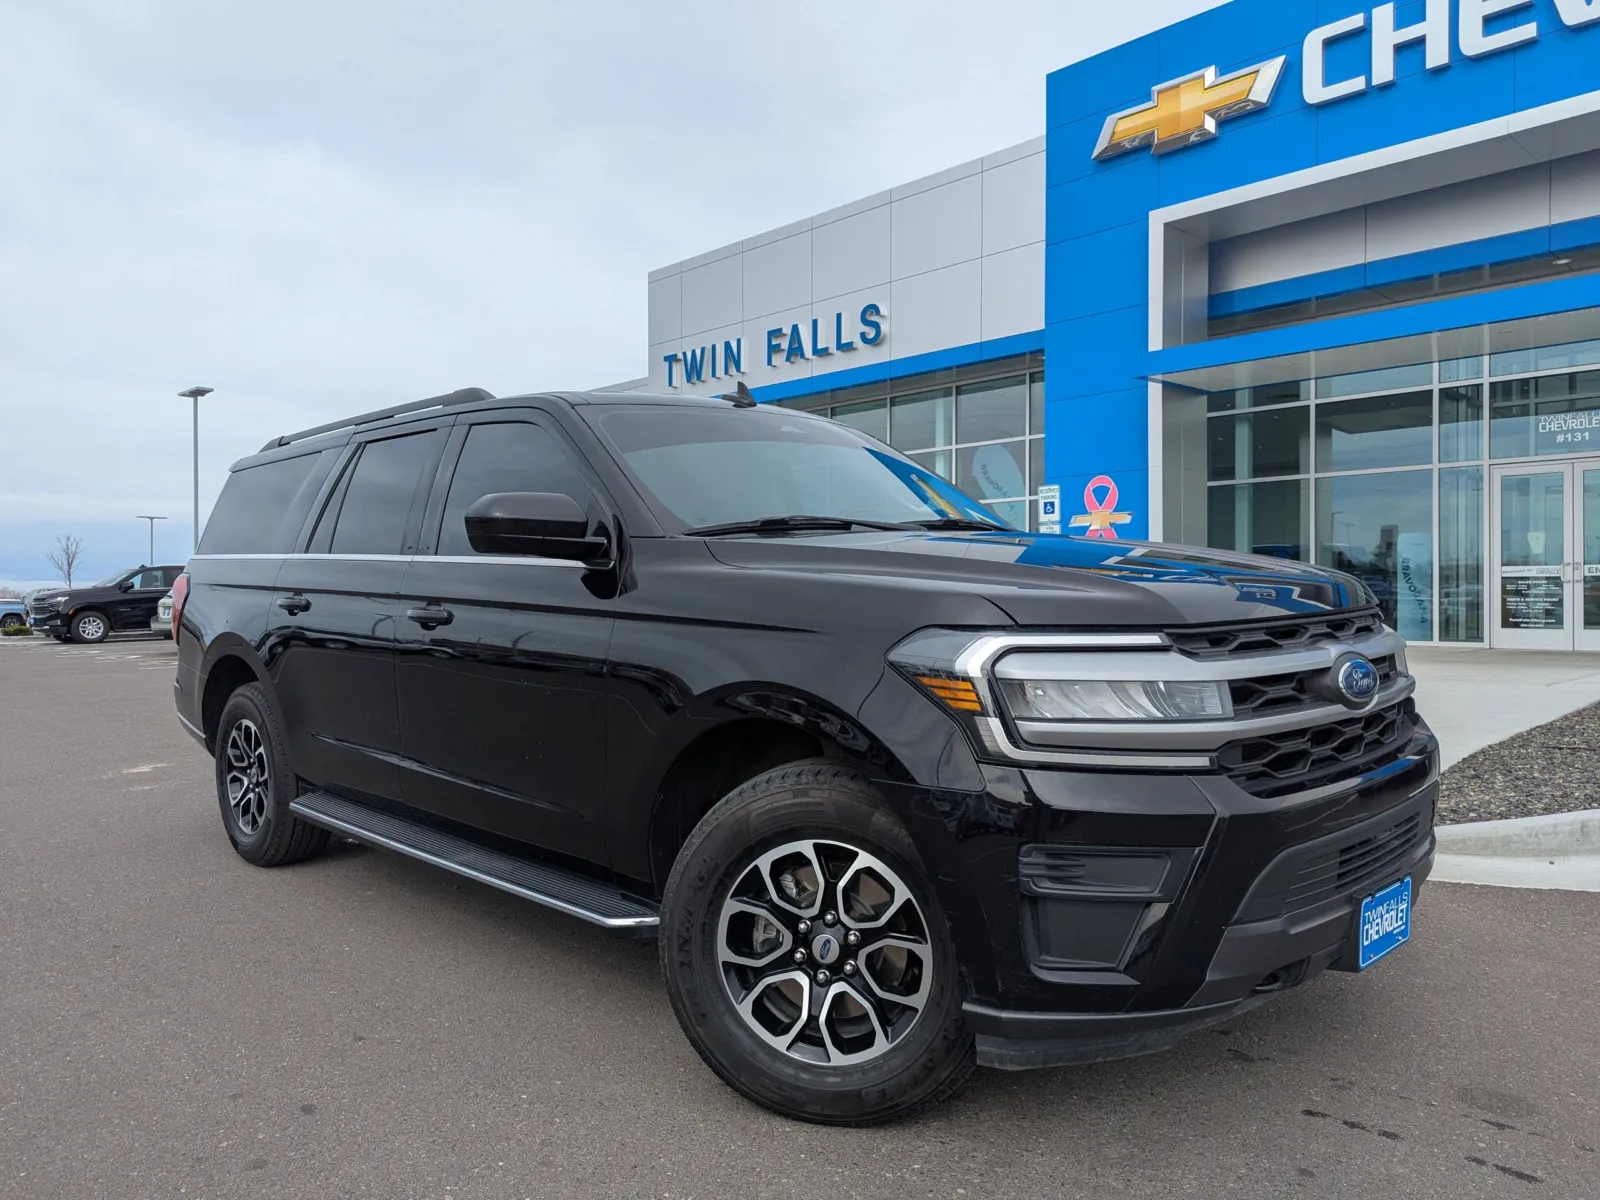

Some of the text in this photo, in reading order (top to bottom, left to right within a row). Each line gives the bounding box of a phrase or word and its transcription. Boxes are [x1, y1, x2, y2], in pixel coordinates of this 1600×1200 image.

[663, 303, 886, 388] TWIN FALLS
[1539, 411, 1600, 423] TWINFALL
[1556, 431, 1590, 443] #131
[1352, 668, 1375, 692] Ford
[1364, 892, 1408, 925] TWINFALLS
[1363, 903, 1408, 946] CHEVROLET
[820, 941, 831, 958] Ford
